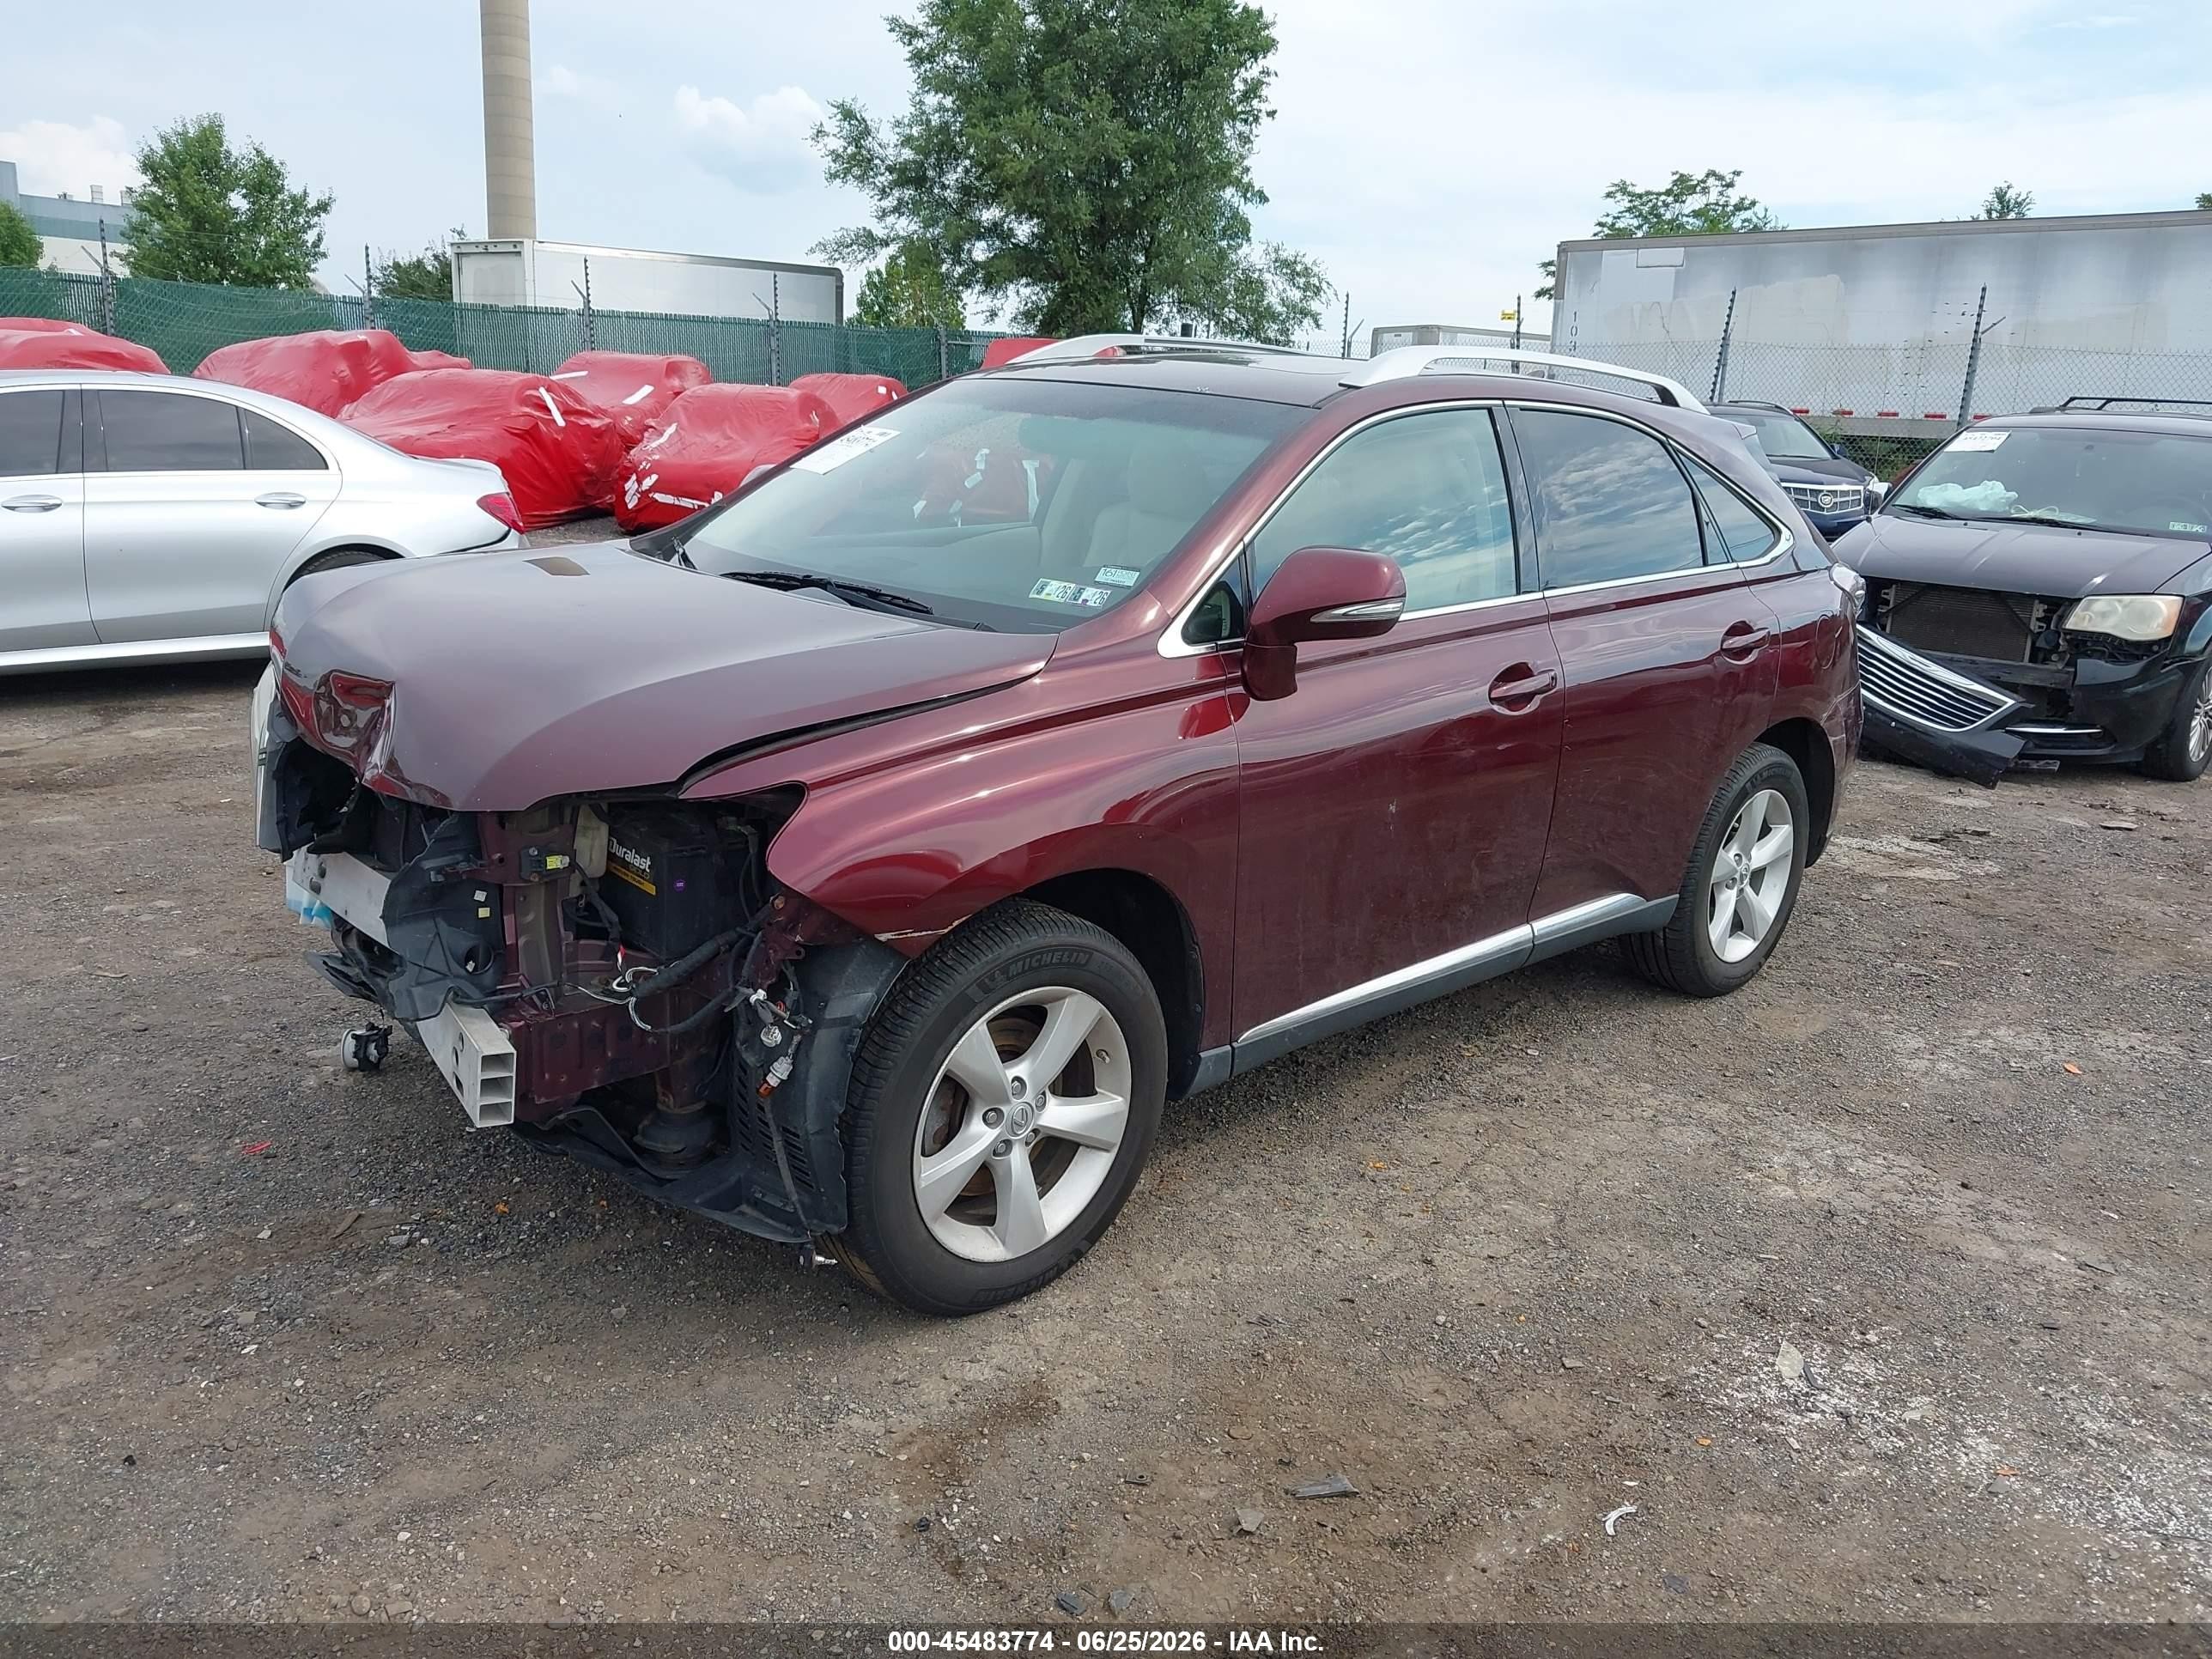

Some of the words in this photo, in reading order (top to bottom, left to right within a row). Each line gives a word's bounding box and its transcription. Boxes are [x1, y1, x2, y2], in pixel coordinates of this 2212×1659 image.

[1101, 568, 1118, 578] 161
[609, 836, 651, 872] Duralast
[1009, 951, 1091, 977] MICHELIN
